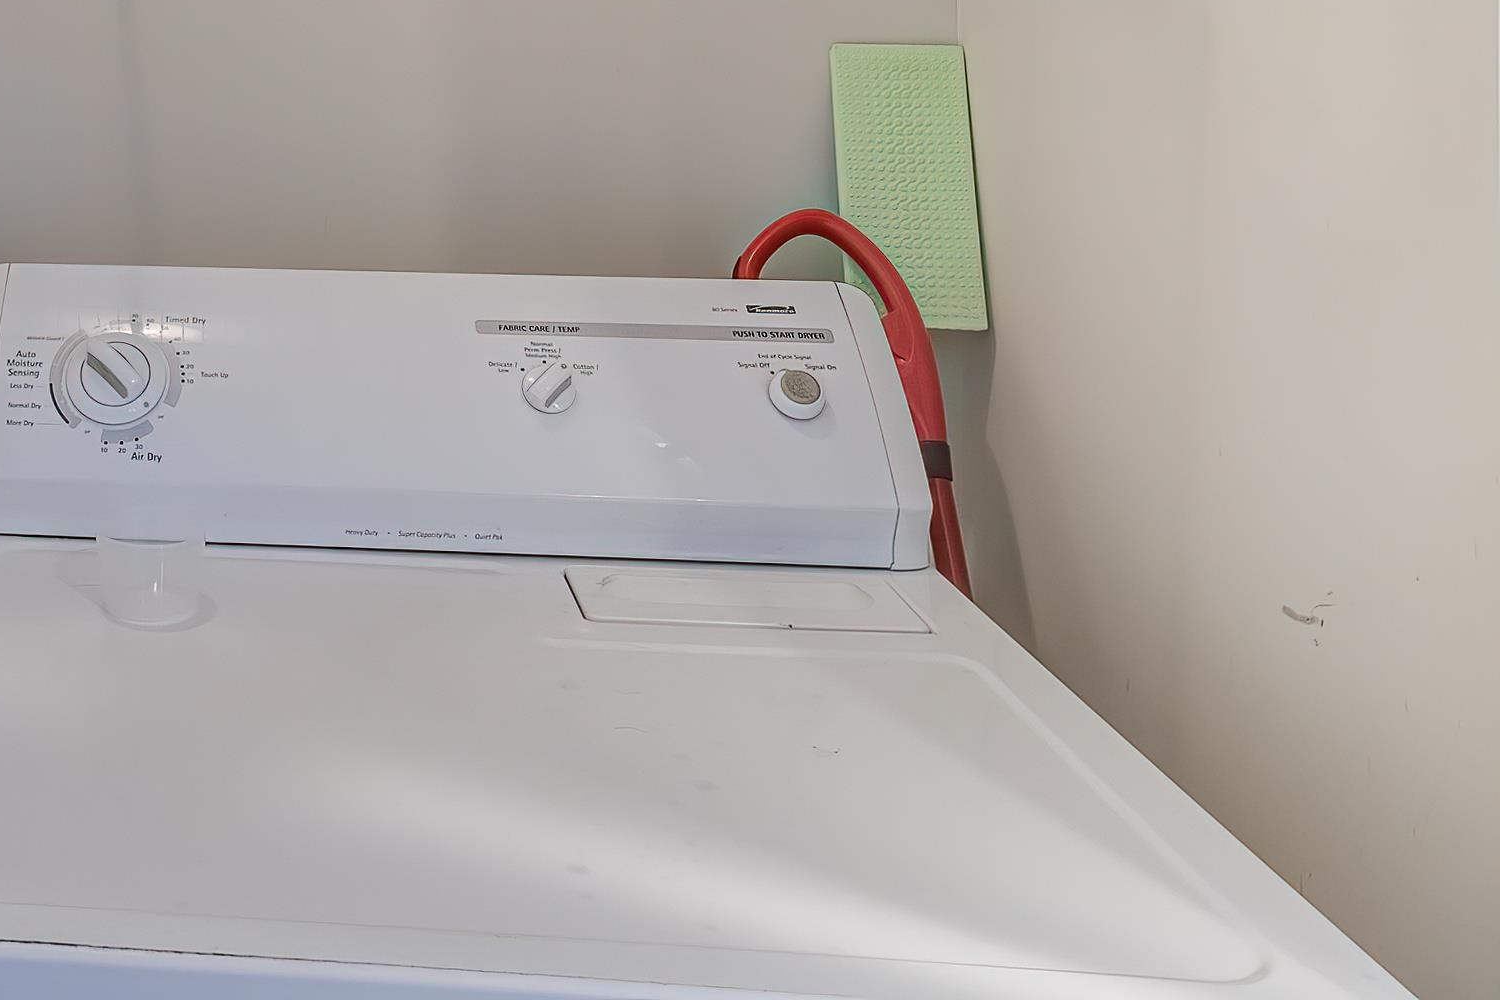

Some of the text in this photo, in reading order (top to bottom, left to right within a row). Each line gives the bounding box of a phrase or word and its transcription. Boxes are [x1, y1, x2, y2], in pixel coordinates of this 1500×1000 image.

[165, 316, 206, 325] Timed Dry
[498, 324, 526, 332] FABRIC
[528, 325, 550, 333] CARE
[732, 330, 755, 338] PUSH
[770, 331, 795, 339] START
[798, 332, 825, 340] DRYER
[16, 350, 36, 358] Auto
[7, 359, 43, 368] Moisture
[804, 363, 825, 371] Signal
[8, 369, 40, 379] Sensing
[131, 452, 162, 463] Air Dry
[364, 529, 378, 537] Duty
[398, 530, 415, 538] Super
[416, 531, 442, 539] Capacity
